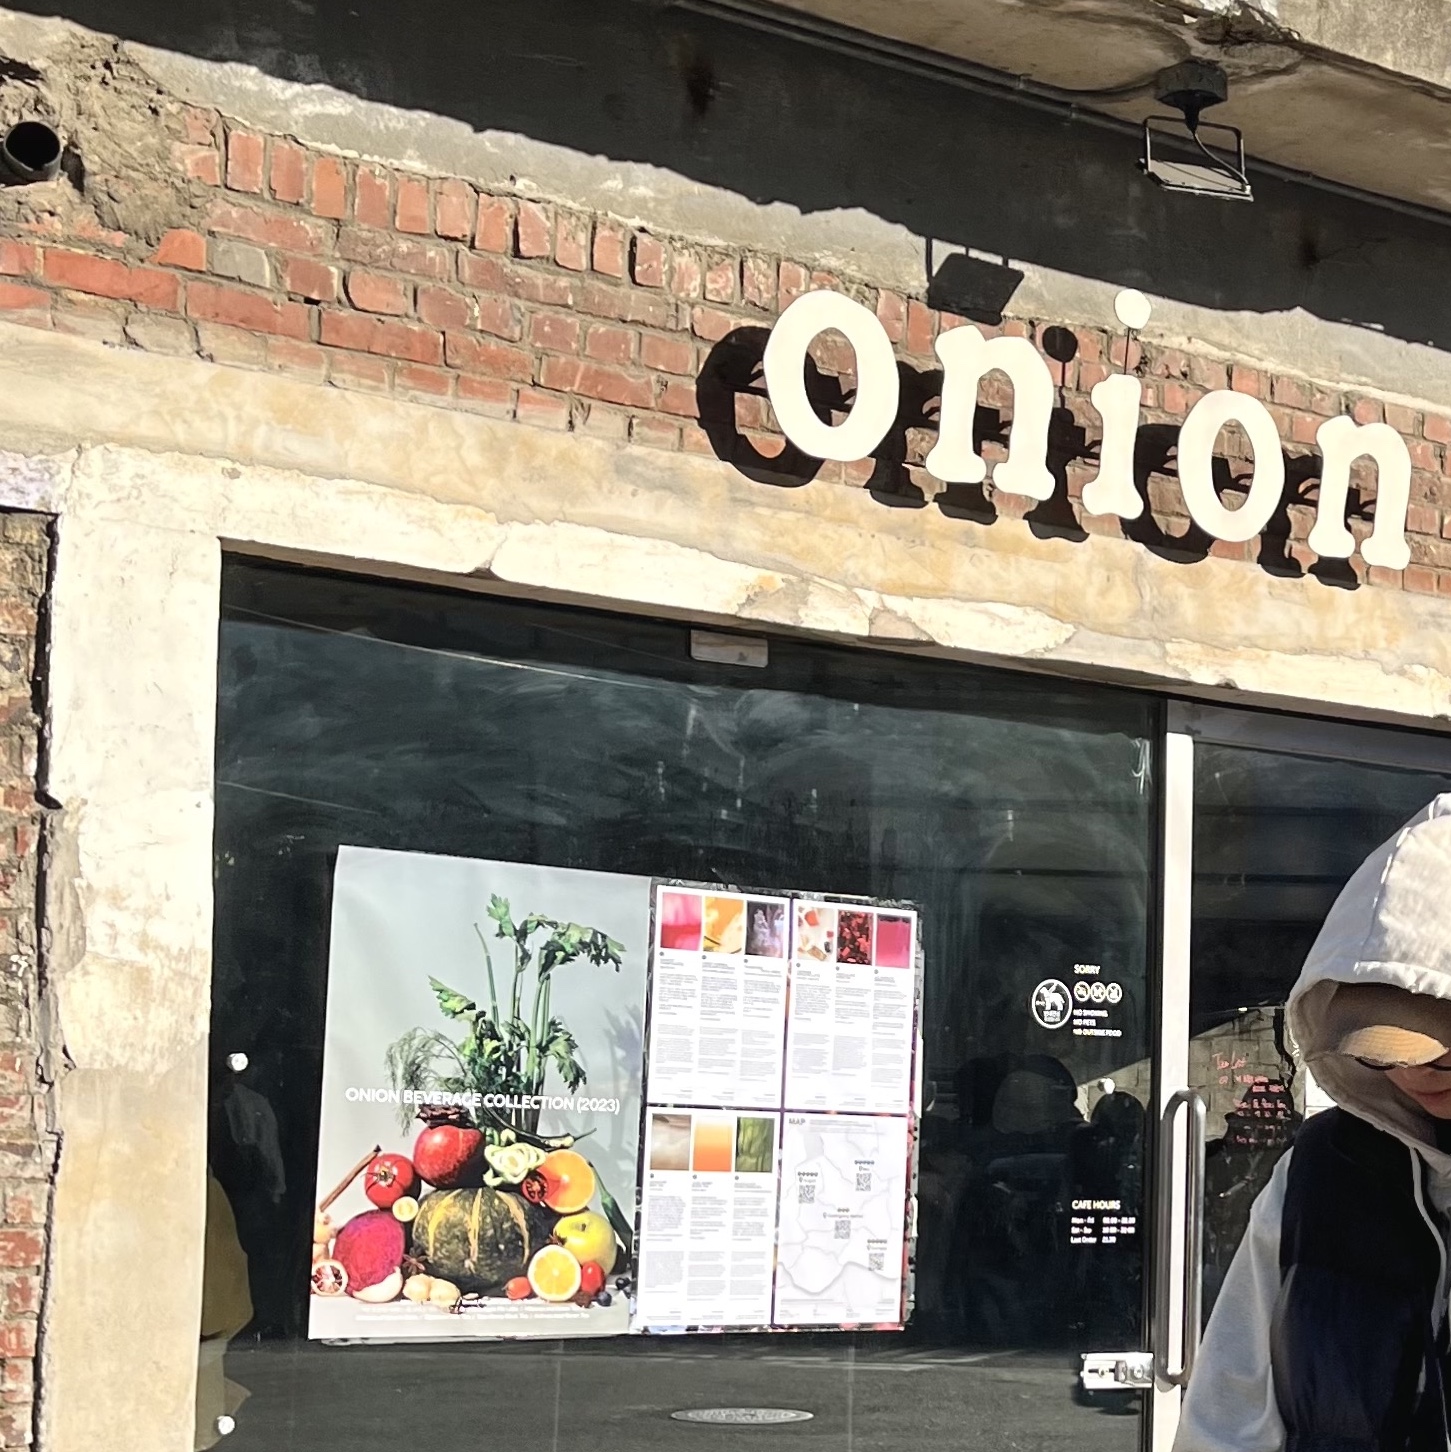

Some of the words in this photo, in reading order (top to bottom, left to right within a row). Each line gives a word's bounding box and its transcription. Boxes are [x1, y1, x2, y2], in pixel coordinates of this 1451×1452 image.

[763, 288, 1412, 570] onion
[1073, 963, 1101, 975] SORRY
[345, 1087, 400, 1104] ONION
[402, 1089, 481, 1108] BEVERAGE
[483, 1093, 575, 1111] COLLECTION
[576, 1096, 621, 1115] (2023)
[1071, 1200, 1092, 1210] CAFE
[1092, 1200, 1121, 1210] HOURS
